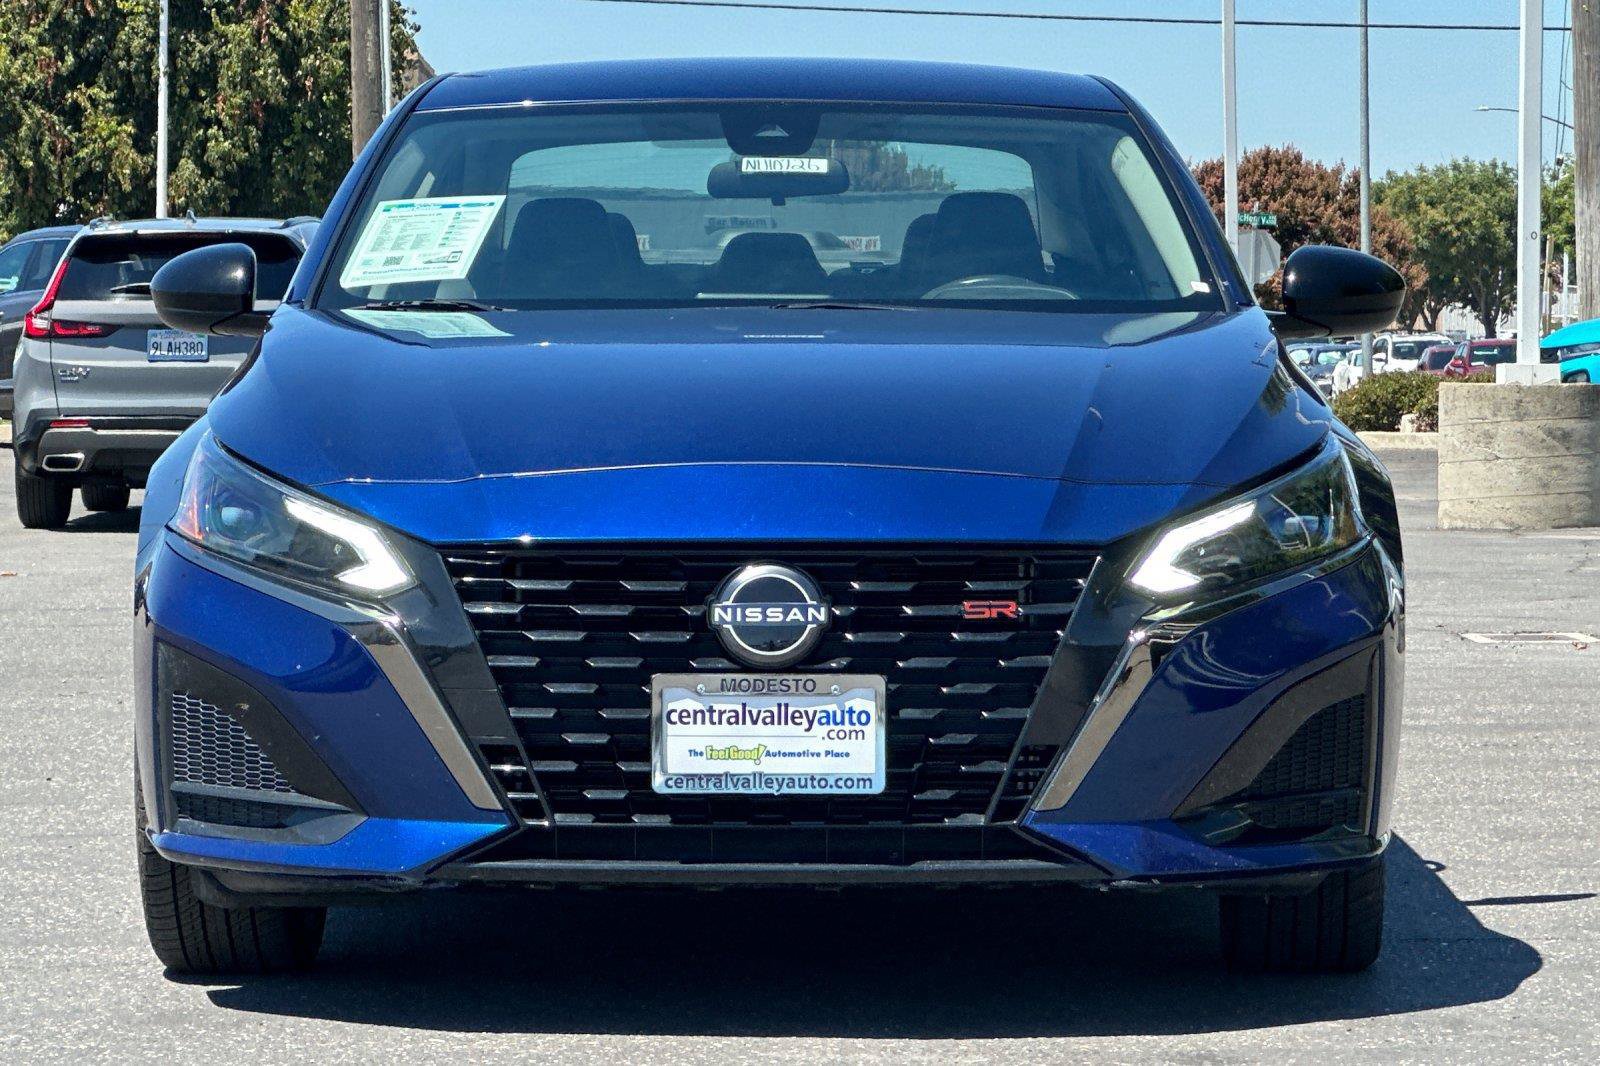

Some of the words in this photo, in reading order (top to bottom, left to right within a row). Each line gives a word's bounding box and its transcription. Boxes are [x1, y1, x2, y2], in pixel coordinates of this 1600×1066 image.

[151, 341, 204, 356] 9LAH380
[714, 607, 825, 622] NISSAN
[963, 600, 1017, 619] SR
[720, 678, 817, 693] MODESTO
[666, 702, 871, 732] centralvalleyauto
[821, 728, 866, 741] .com
[825, 750, 850, 758] Place
[664, 771, 873, 793] centralvalleyauto.com
